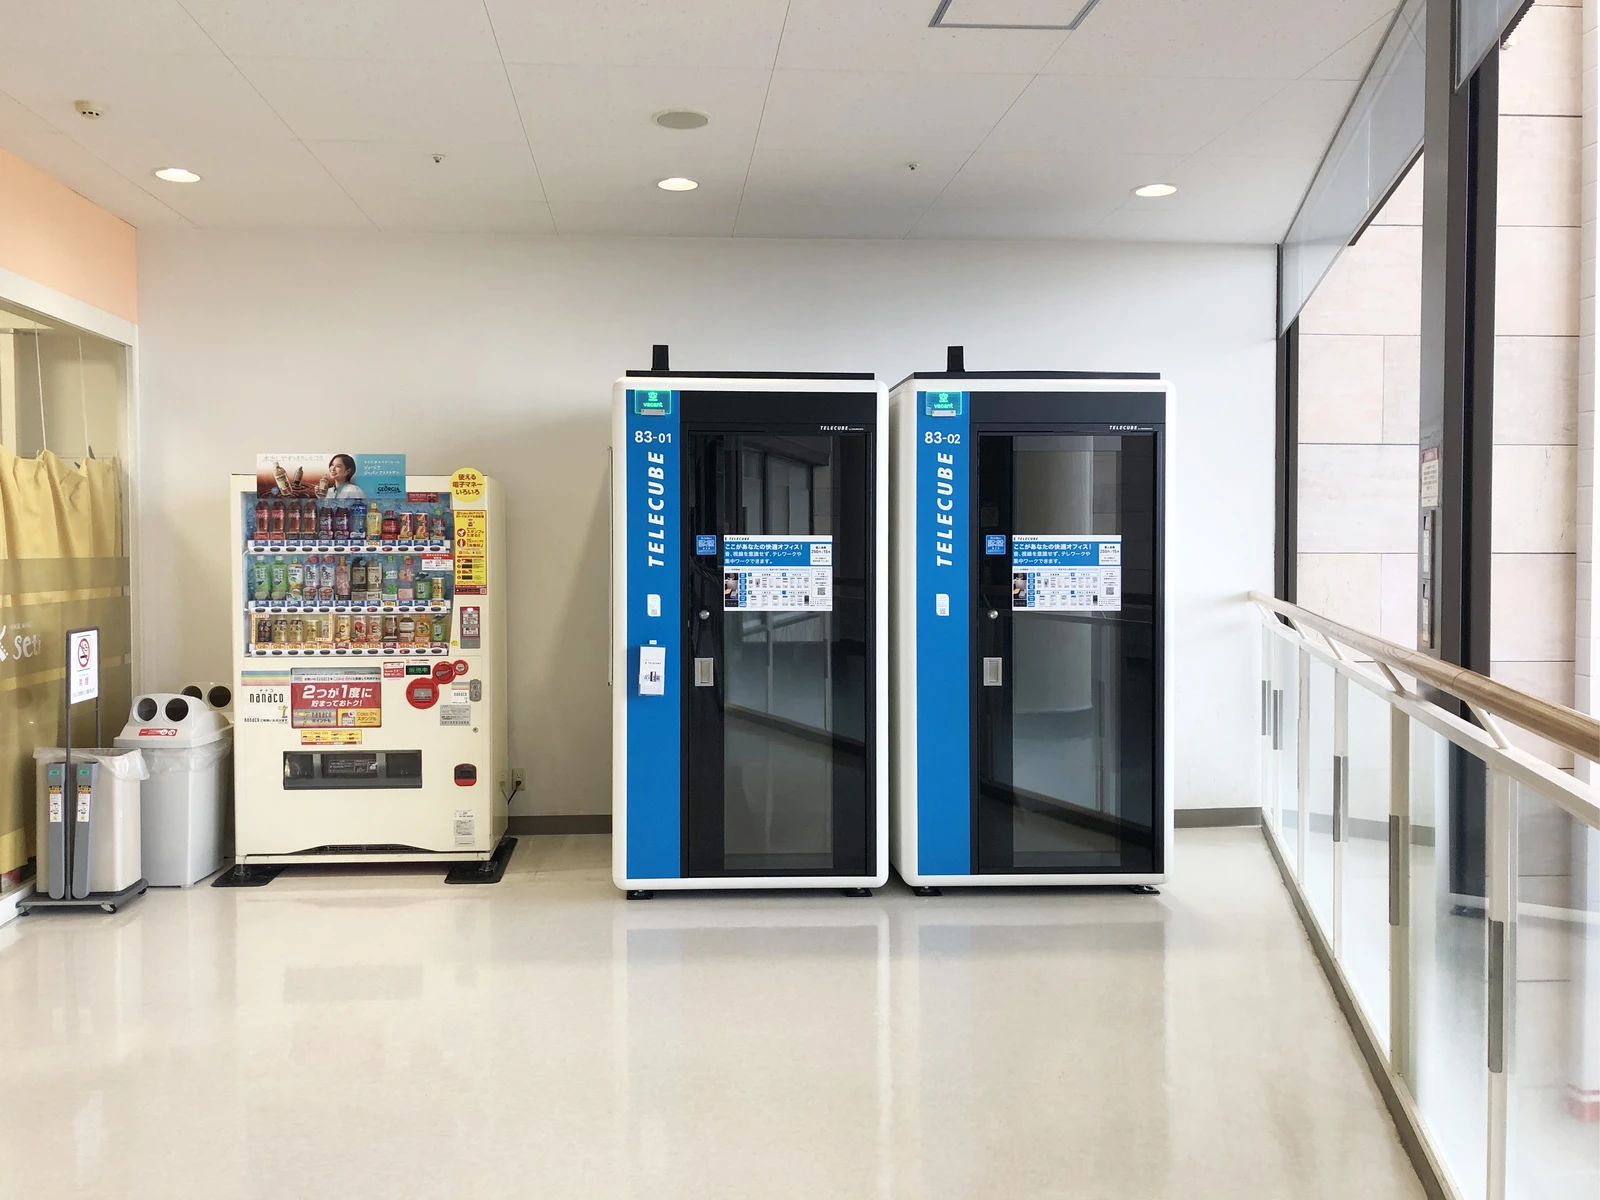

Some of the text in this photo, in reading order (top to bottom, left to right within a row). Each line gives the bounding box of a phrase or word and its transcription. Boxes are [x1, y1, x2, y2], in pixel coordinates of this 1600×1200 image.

[634, 431, 672, 444] 83-01
[924, 431, 961, 444] 83-02
[648, 452, 664, 567] TELECUBE
[937, 452, 953, 567] TELECUBE
[249, 693, 284, 703] nanaco
[302, 684, 373, 699] 2つが1度に
